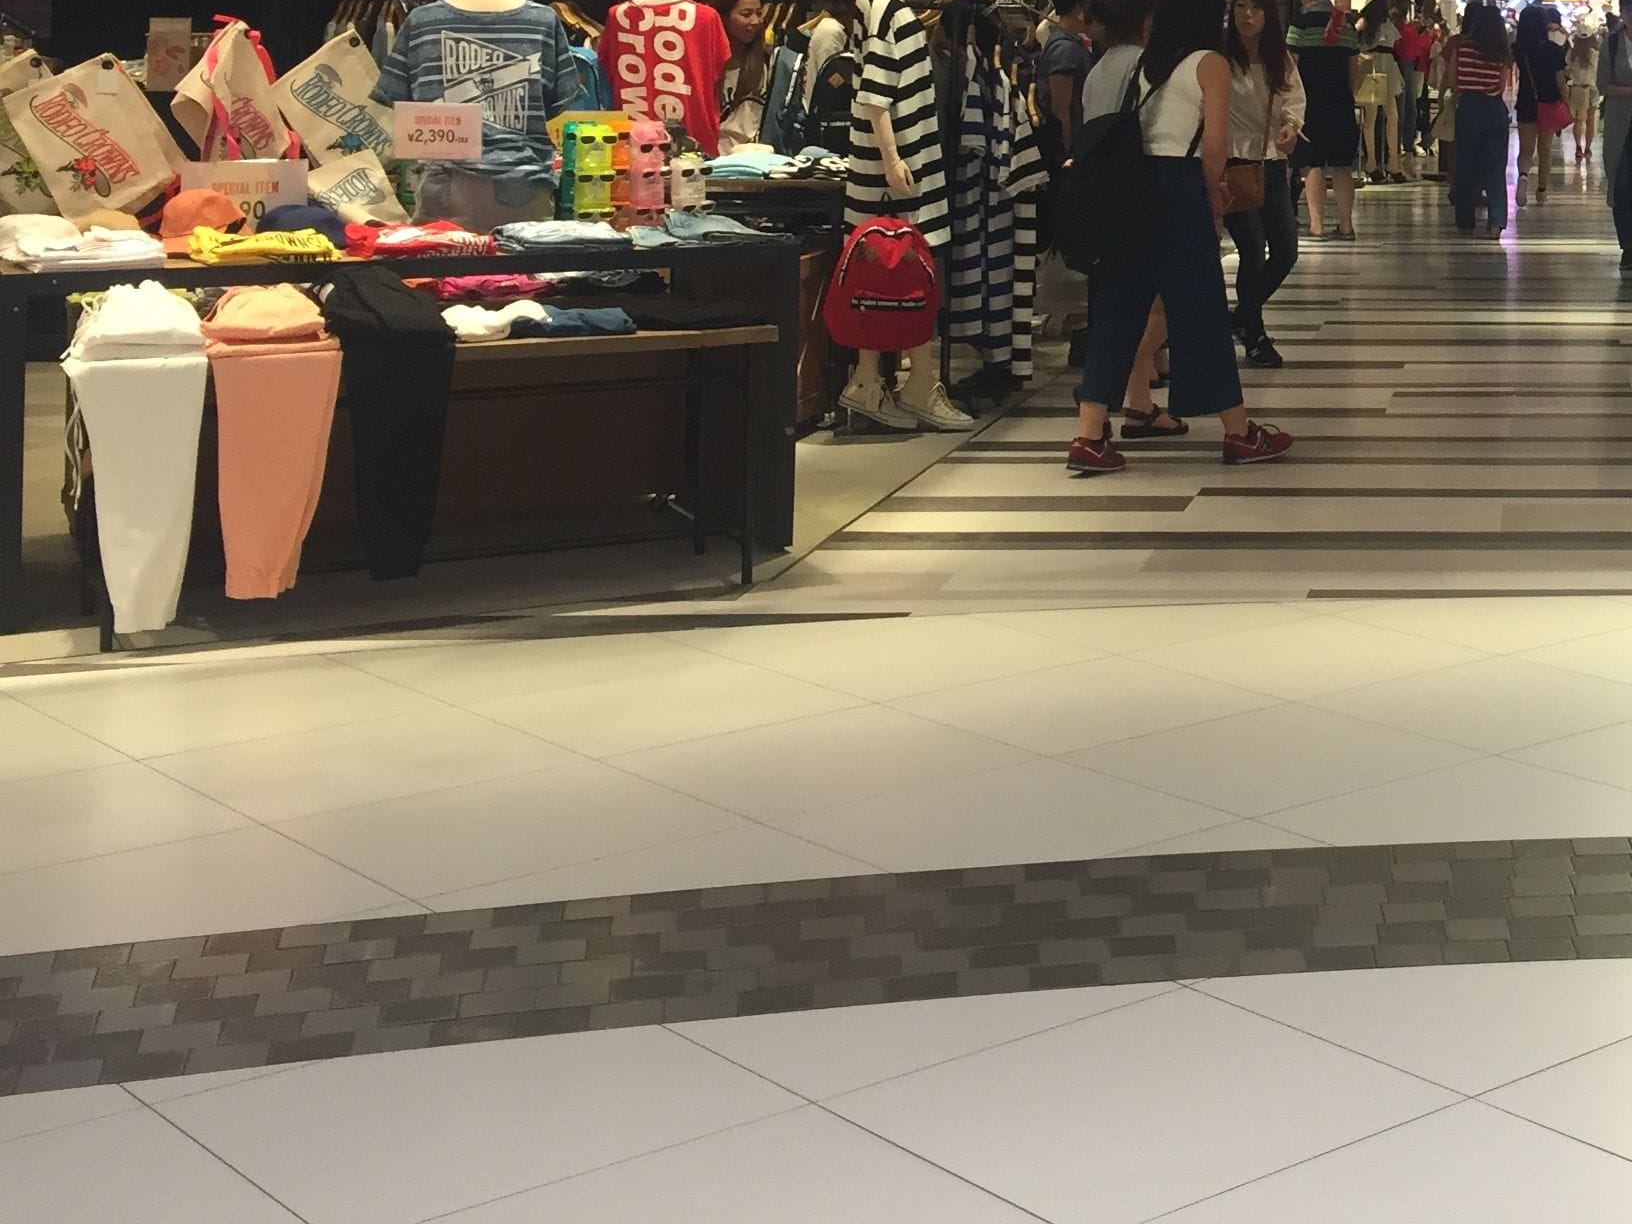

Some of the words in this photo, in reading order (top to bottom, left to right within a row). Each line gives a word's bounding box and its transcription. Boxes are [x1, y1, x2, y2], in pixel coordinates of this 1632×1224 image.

[445, 38, 504, 80] RODEO
[616, 1, 649, 122] Crow
[653, 1, 697, 122] Rode
